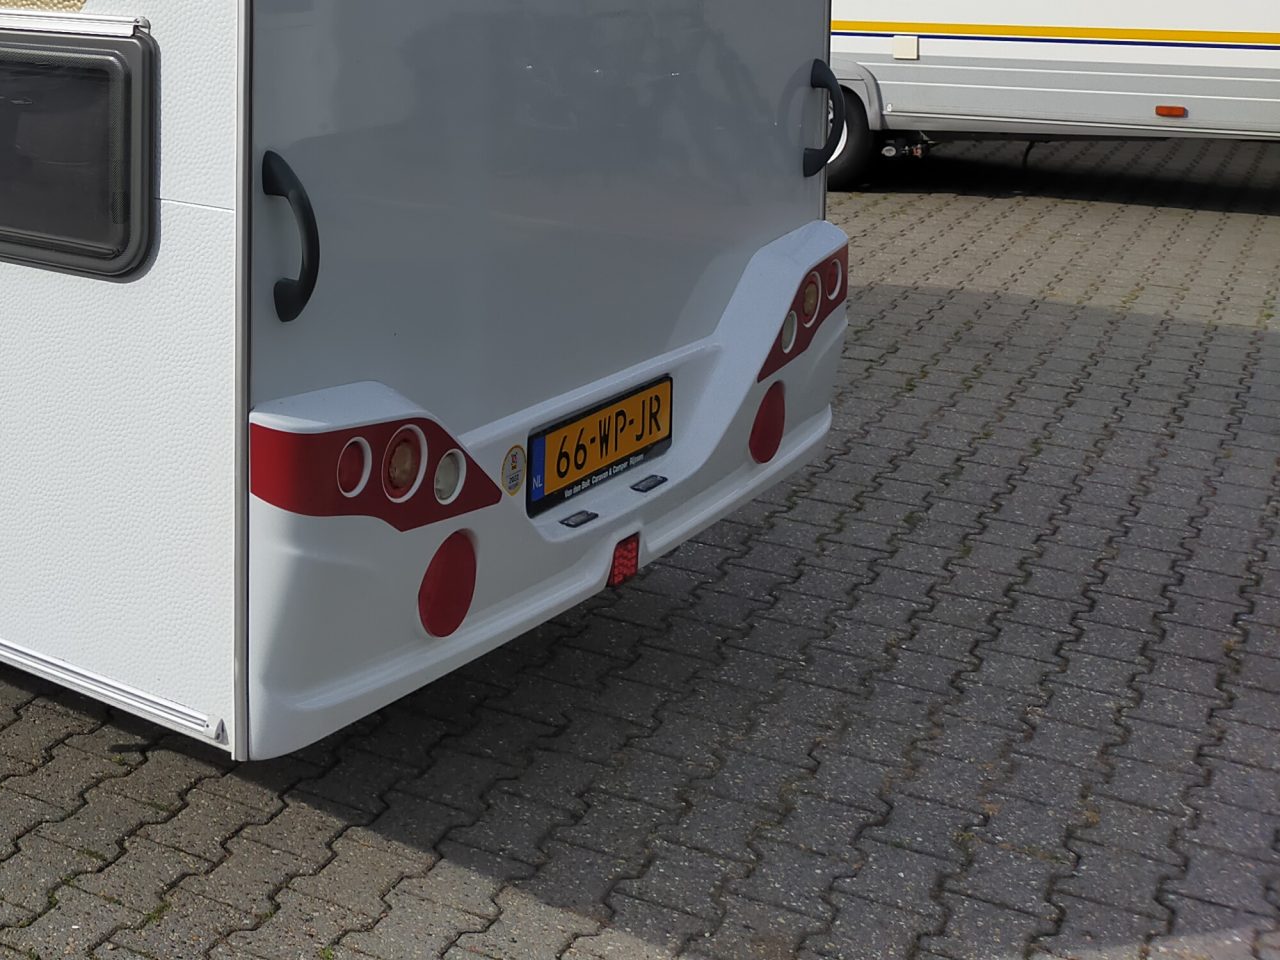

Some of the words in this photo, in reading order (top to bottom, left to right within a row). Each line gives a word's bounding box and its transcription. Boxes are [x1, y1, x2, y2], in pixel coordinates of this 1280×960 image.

[555, 393, 662, 480] 66-WP-JR
[532, 474, 544, 489] NL
[591, 470, 609, 485] Caravan
